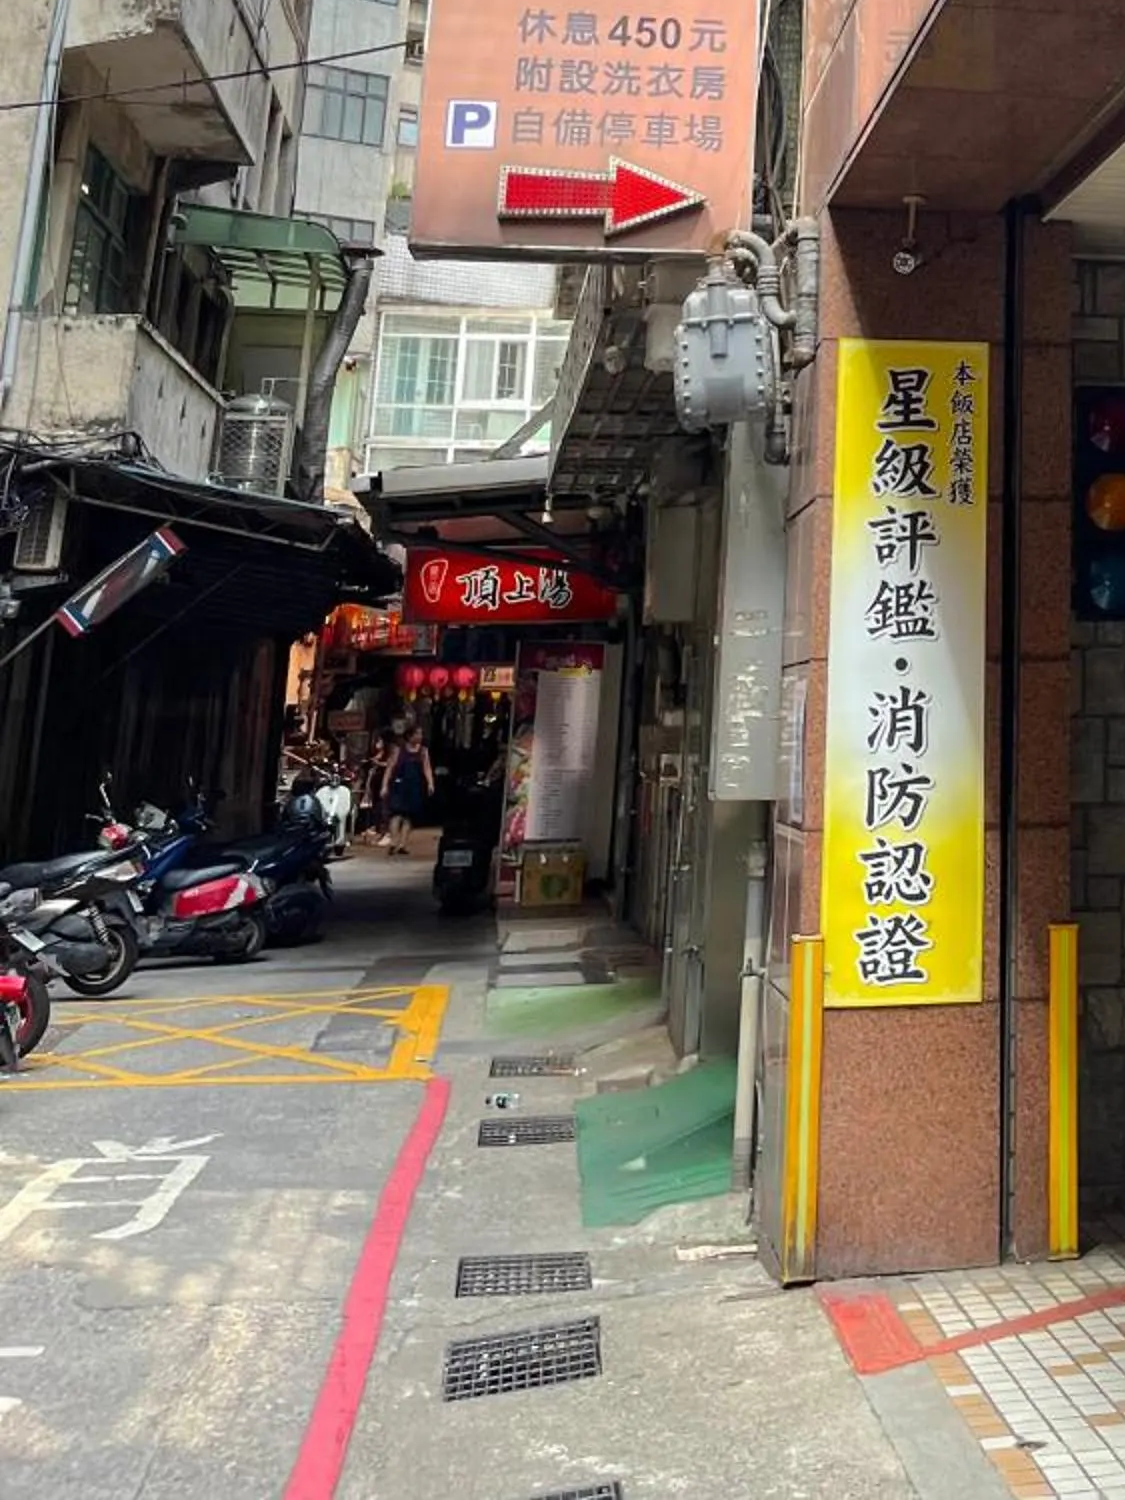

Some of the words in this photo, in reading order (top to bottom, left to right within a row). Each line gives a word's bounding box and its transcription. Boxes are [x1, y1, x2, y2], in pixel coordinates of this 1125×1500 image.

[517, 8, 727, 53] 休息450元
[515, 57, 726, 100] 附設洗衣房
[451, 104, 491, 145] P
[511, 106, 723, 152] 自備停車場
[949, 360, 976, 505] 本飯店榮獲
